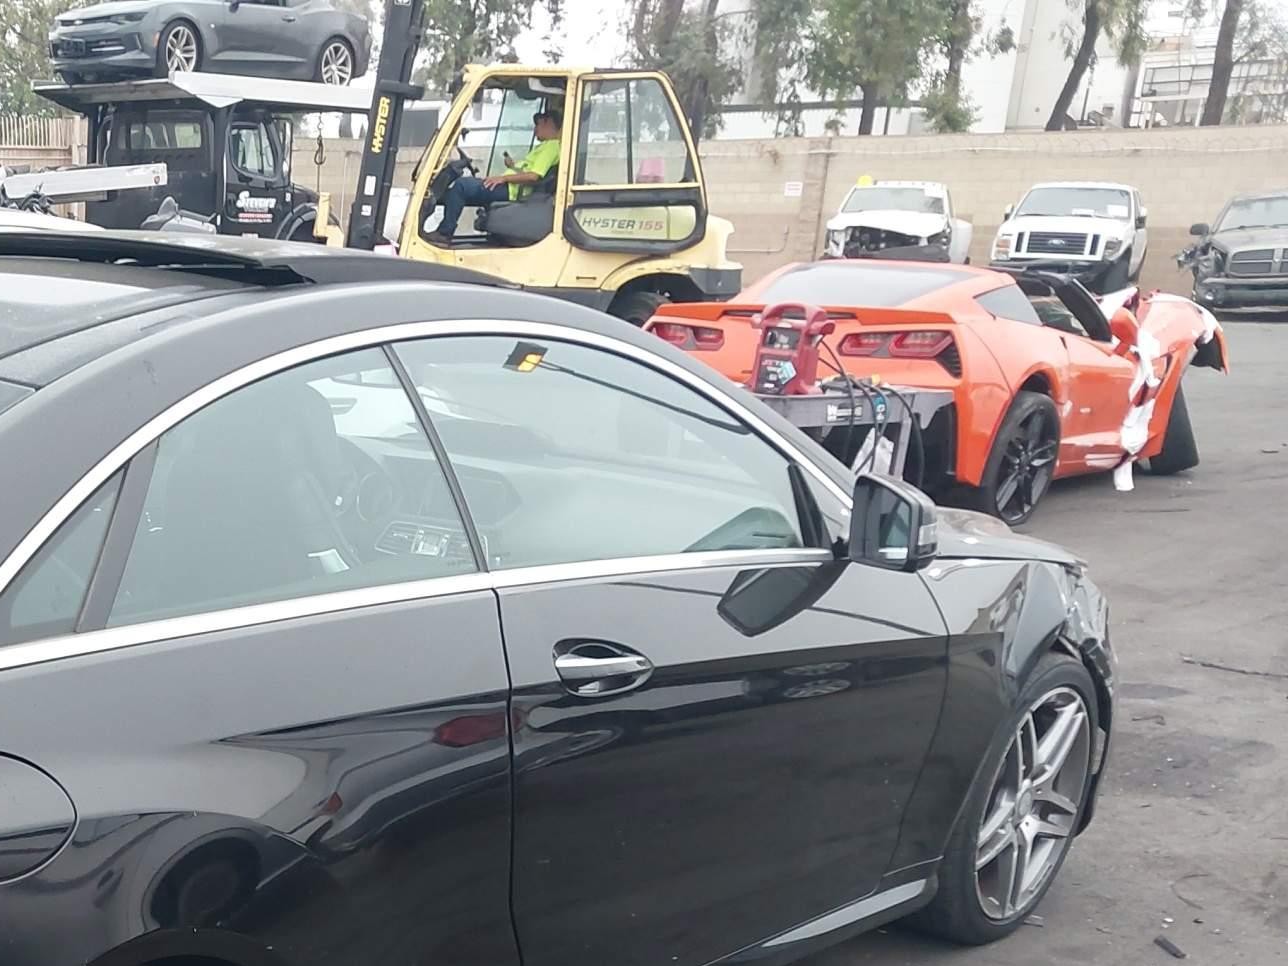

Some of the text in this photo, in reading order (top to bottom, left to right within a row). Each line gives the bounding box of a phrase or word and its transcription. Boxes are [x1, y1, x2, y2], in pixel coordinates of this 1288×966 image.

[371, 96, 391, 153] HYSTER
[582, 217, 665, 231] HYSTER 155
